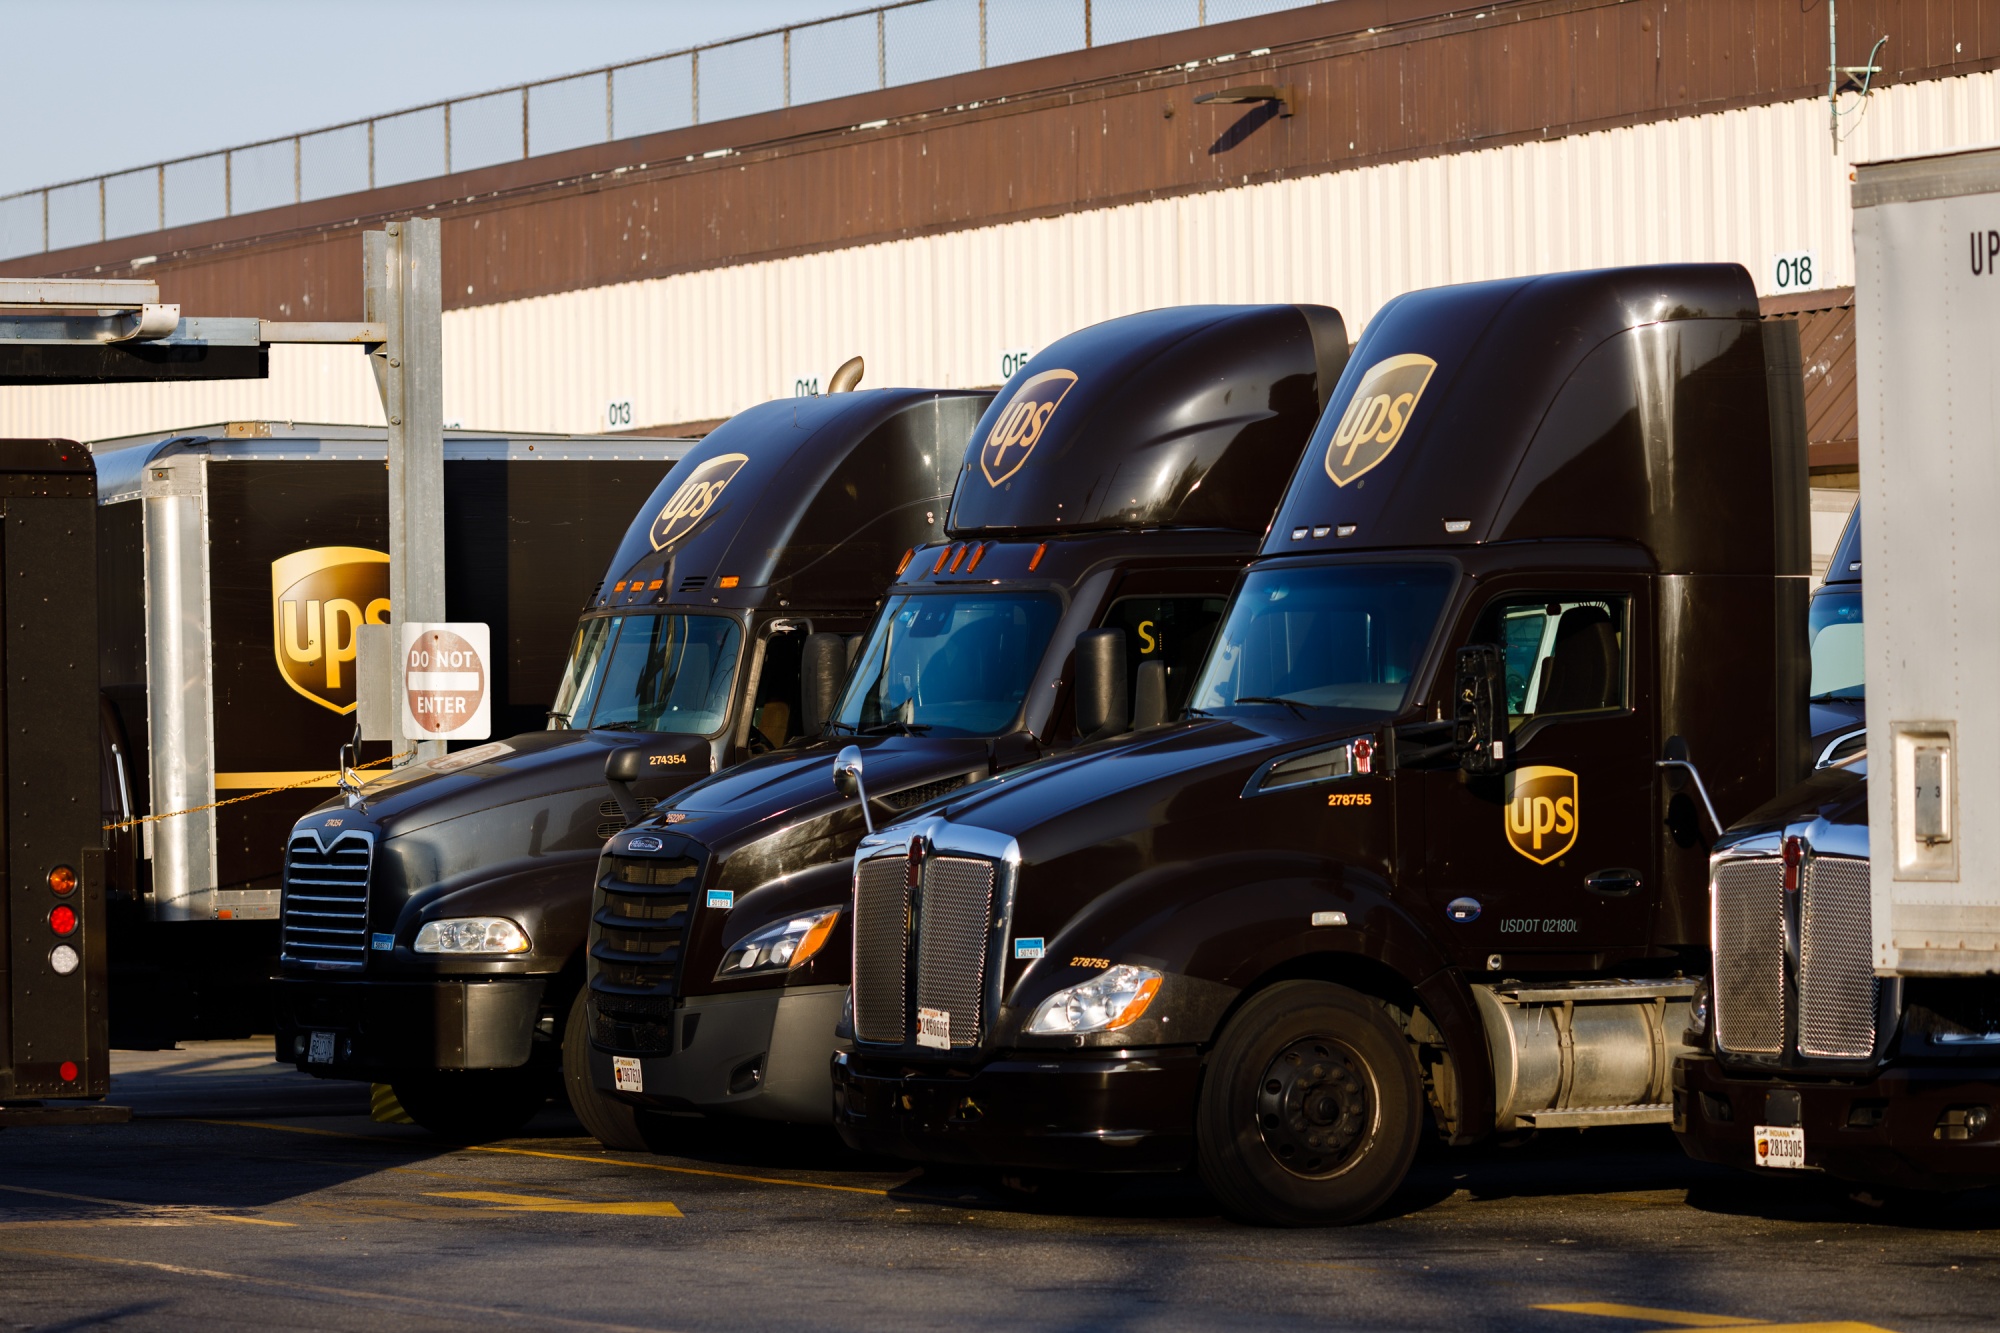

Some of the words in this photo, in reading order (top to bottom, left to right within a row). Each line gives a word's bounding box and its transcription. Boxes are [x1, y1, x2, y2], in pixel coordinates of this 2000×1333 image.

[1970, 230, 2000, 276] UP
[1776, 256, 1813, 287] 018
[795, 378, 819, 399] 014
[609, 402, 631, 425] 013
[990, 401, 1054, 467] ups
[1335, 392, 1414, 467] ups
[661, 480, 725, 535] ups
[411, 650, 429, 668] DO
[436, 651, 473, 668] NOT
[417, 696, 466, 714] ENTER
[649, 754, 687, 765] 274354
[1328, 794, 1372, 806] 278755
[1510, 796, 1574, 850] ups
[1500, 919, 1540, 933] USDOT
[1069, 957, 1110, 969] 278755
[1769, 1129, 1791, 1138] INDIANA
[1770, 1138, 1803, 1159] 2813305
